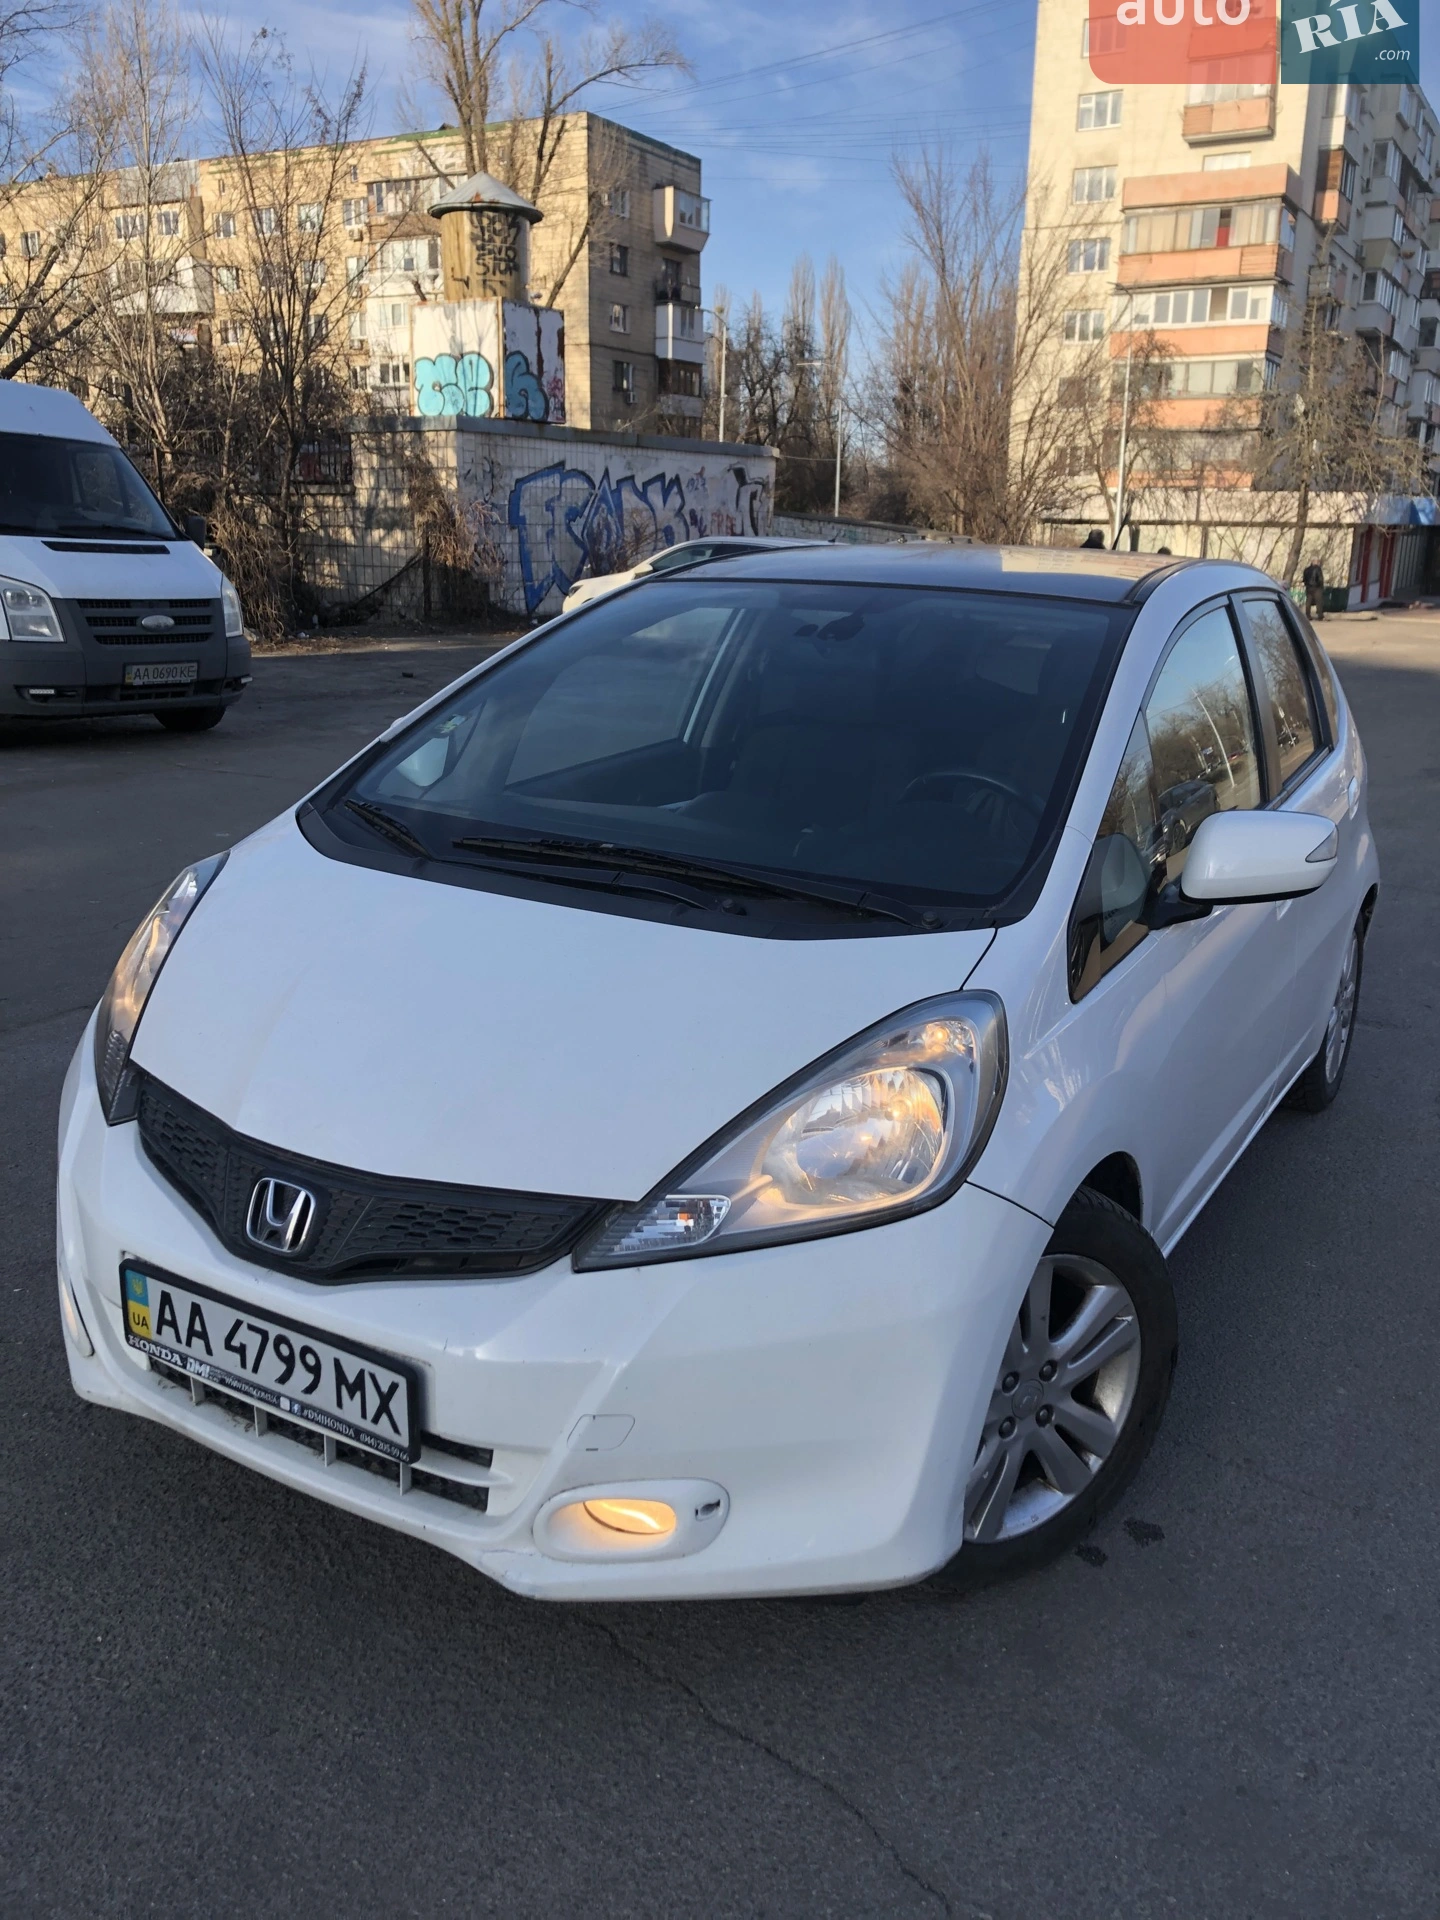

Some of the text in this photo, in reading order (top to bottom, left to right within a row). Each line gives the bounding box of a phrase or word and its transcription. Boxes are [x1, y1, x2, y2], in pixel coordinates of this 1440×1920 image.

[134, 667, 150, 680] AA
[152, 666, 178, 680] 0690
[180, 665, 195, 678] KE
[132, 1312, 150, 1330] UA
[127, 1334, 183, 1366] HONDA
[186, 1357, 211, 1378] DMI
[303, 1409, 355, 1438] #DMIHONDA
[156, 1290, 401, 1436] AA 4799 MX
